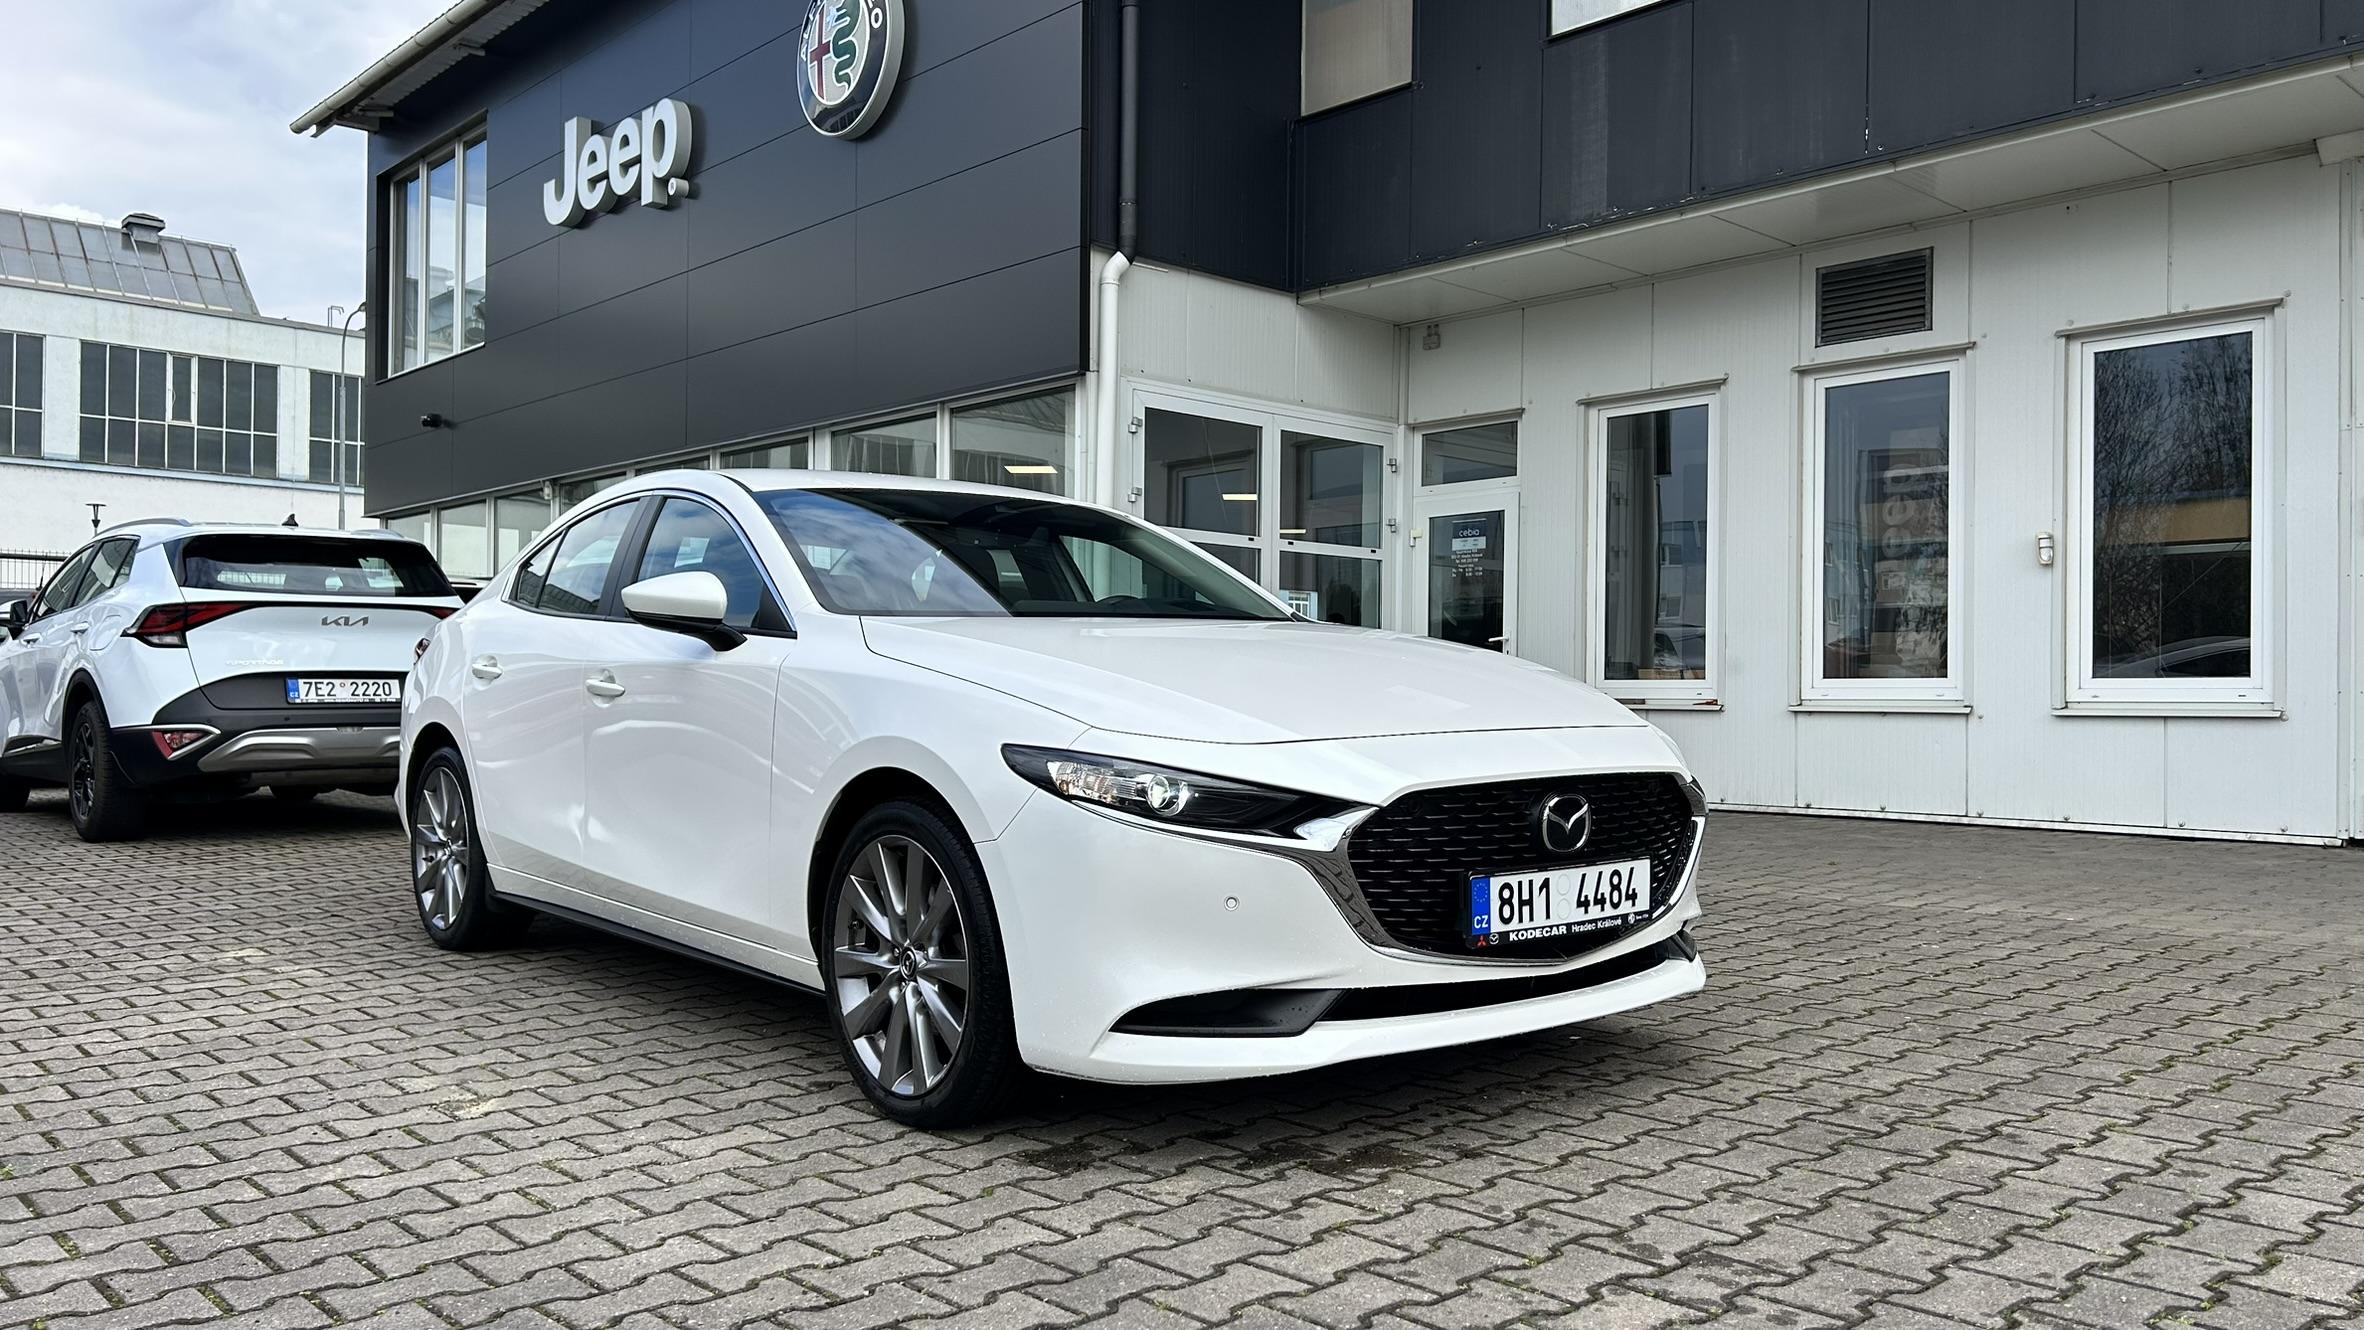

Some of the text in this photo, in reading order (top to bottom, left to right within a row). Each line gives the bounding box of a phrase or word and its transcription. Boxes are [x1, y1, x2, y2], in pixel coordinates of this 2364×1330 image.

[543, 97, 692, 228] Jeep
[321, 616, 369, 627] KIA
[303, 681, 392, 697] 7E2 2220
[1498, 866, 1638, 925] 8H1 4484
[1473, 914, 1489, 930] CZ
[1509, 925, 1567, 942] KODECAR
[1571, 923, 1596, 933] Hradec
[1597, 916, 1622, 929] Králové
